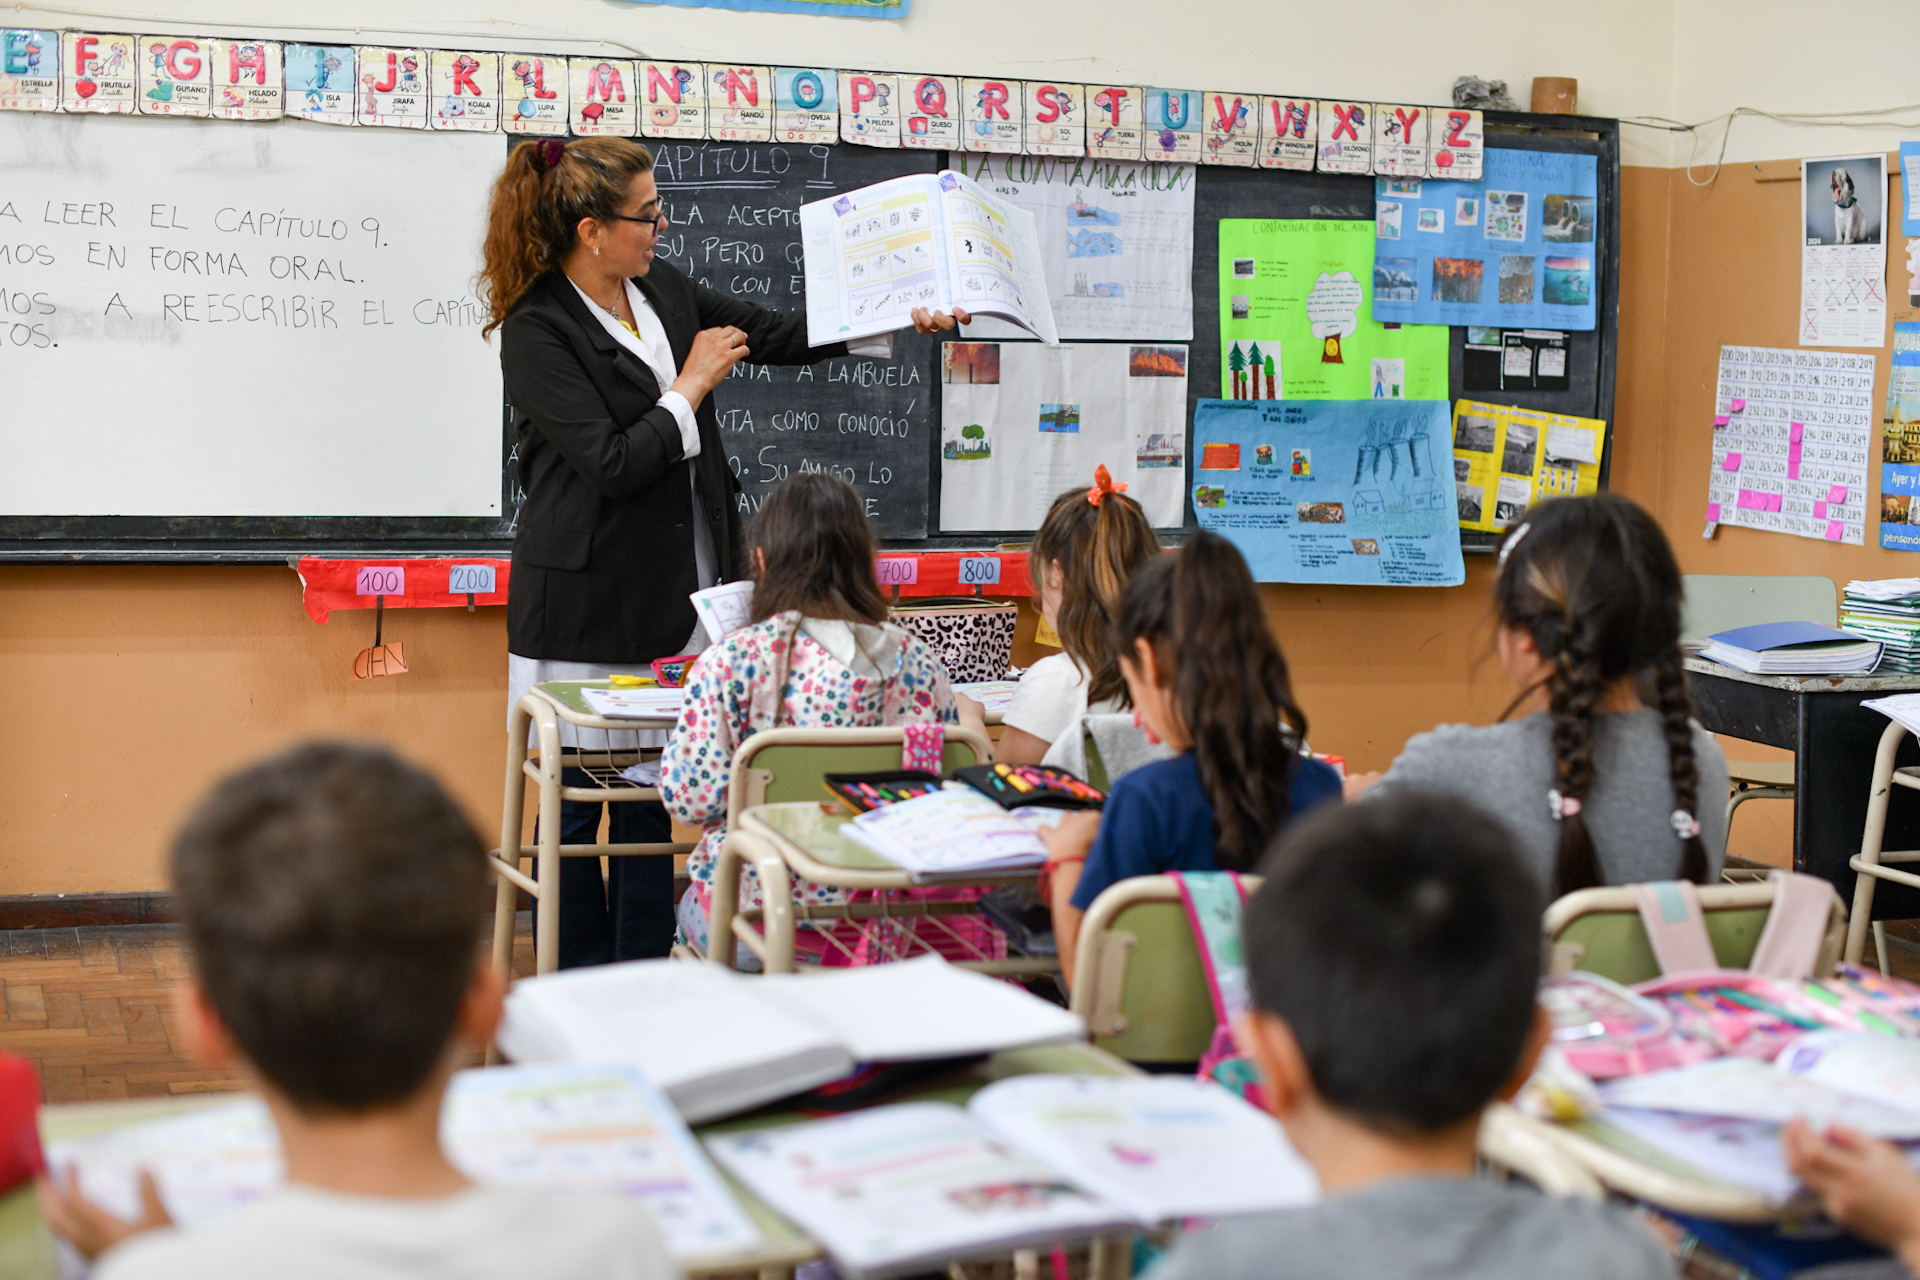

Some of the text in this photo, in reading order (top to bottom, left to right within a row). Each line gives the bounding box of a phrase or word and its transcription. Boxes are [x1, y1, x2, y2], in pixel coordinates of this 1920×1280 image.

[4, 34, 28, 74] E
[75, 37, 99, 76] F
[166, 40, 201, 80] G
[229, 43, 266, 84] H
[315, 48, 325, 89] I
[374, 52, 397, 92] J
[176, 85, 207, 93] GUSANO
[248, 89, 277, 97] HELADO
[453, 58, 481, 96] K
[534, 58, 556, 99] L
[586, 67, 625, 102] M
[647, 64, 680, 103] N
[727, 68, 757, 106] Ñ
[791, 71, 824, 109] O
[850, 76, 875, 113] P
[914, 77, 947, 118] Q
[983, 81, 1009, 119] R
[1036, 84, 1059, 123] S
[1104, 88, 1126, 126] T
[1161, 91, 1188, 129] U
[1214, 95, 1242, 132] V
[871, 119, 894, 127] PELOTA
[997, 124, 1018, 132] RATÓN
[1271, 100, 1310, 138] W
[1331, 104, 1358, 141] X
[1395, 107, 1420, 144] Y
[1447, 111, 1471, 147] Z
[637, 142, 829, 180] APÍTULO 9
[44, 200, 116, 227] LEER
[150, 204, 189, 230] EL
[215, 208, 348, 240] CAPÍTULO
[361, 217, 388, 248] 9.
[1807, 237, 1822, 245] 2024
[87, 242, 126, 270] EN
[150, 247, 248, 277] FORMA
[269, 255, 365, 283] ORAL.
[701, 236, 764, 266] PERO
[730, 275, 771, 295] CON
[104, 292, 133, 320] A
[363, 299, 394, 325] EL
[797, 364, 814, 383] A
[1721, 349, 1733, 360] 200
[1736, 351, 1748, 362] 201
[1752, 351, 1764, 363] 202
[1767, 352, 1779, 364] 203
[1796, 355, 1807, 366] 205
[1810, 356, 1822, 367] 206
[1826, 357, 1838, 368] 207
[1842, 358, 1856, 369] 208
[1859, 358, 1873, 370] 209
[1721, 367, 1732, 379] 210
[1736, 367, 1746, 379] 211
[1766, 370, 1777, 382] 213
[1795, 373, 1805, 384] 215
[1825, 375, 1837, 386] 217
[1841, 376, 1854, 387] 218
[1858, 378, 1870, 388] 219
[772, 410, 820, 431] COMO
[838, 398, 916, 438] CONOCIÓ
[1840, 395, 1853, 405] 228
[1856, 396, 1868, 406] 229
[1821, 430, 1866, 445] 247 248 249
[1838, 413, 1851, 424] 238
[1854, 415, 1868, 426] 239
[868, 461, 892, 484] LO
[1835, 450, 1865, 464] 258 259
[1833, 471, 1862, 485] 268 269
[1891, 471, 1917, 489] Ayer y
[1831, 507, 1861, 521] 288 289
[1847, 526, 1860, 539] 299
[360, 571, 398, 592] 100
[455, 568, 489, 590] 200
[881, 561, 912, 582] 700
[964, 560, 994, 582] 800
[354, 642, 408, 678] CIEN
